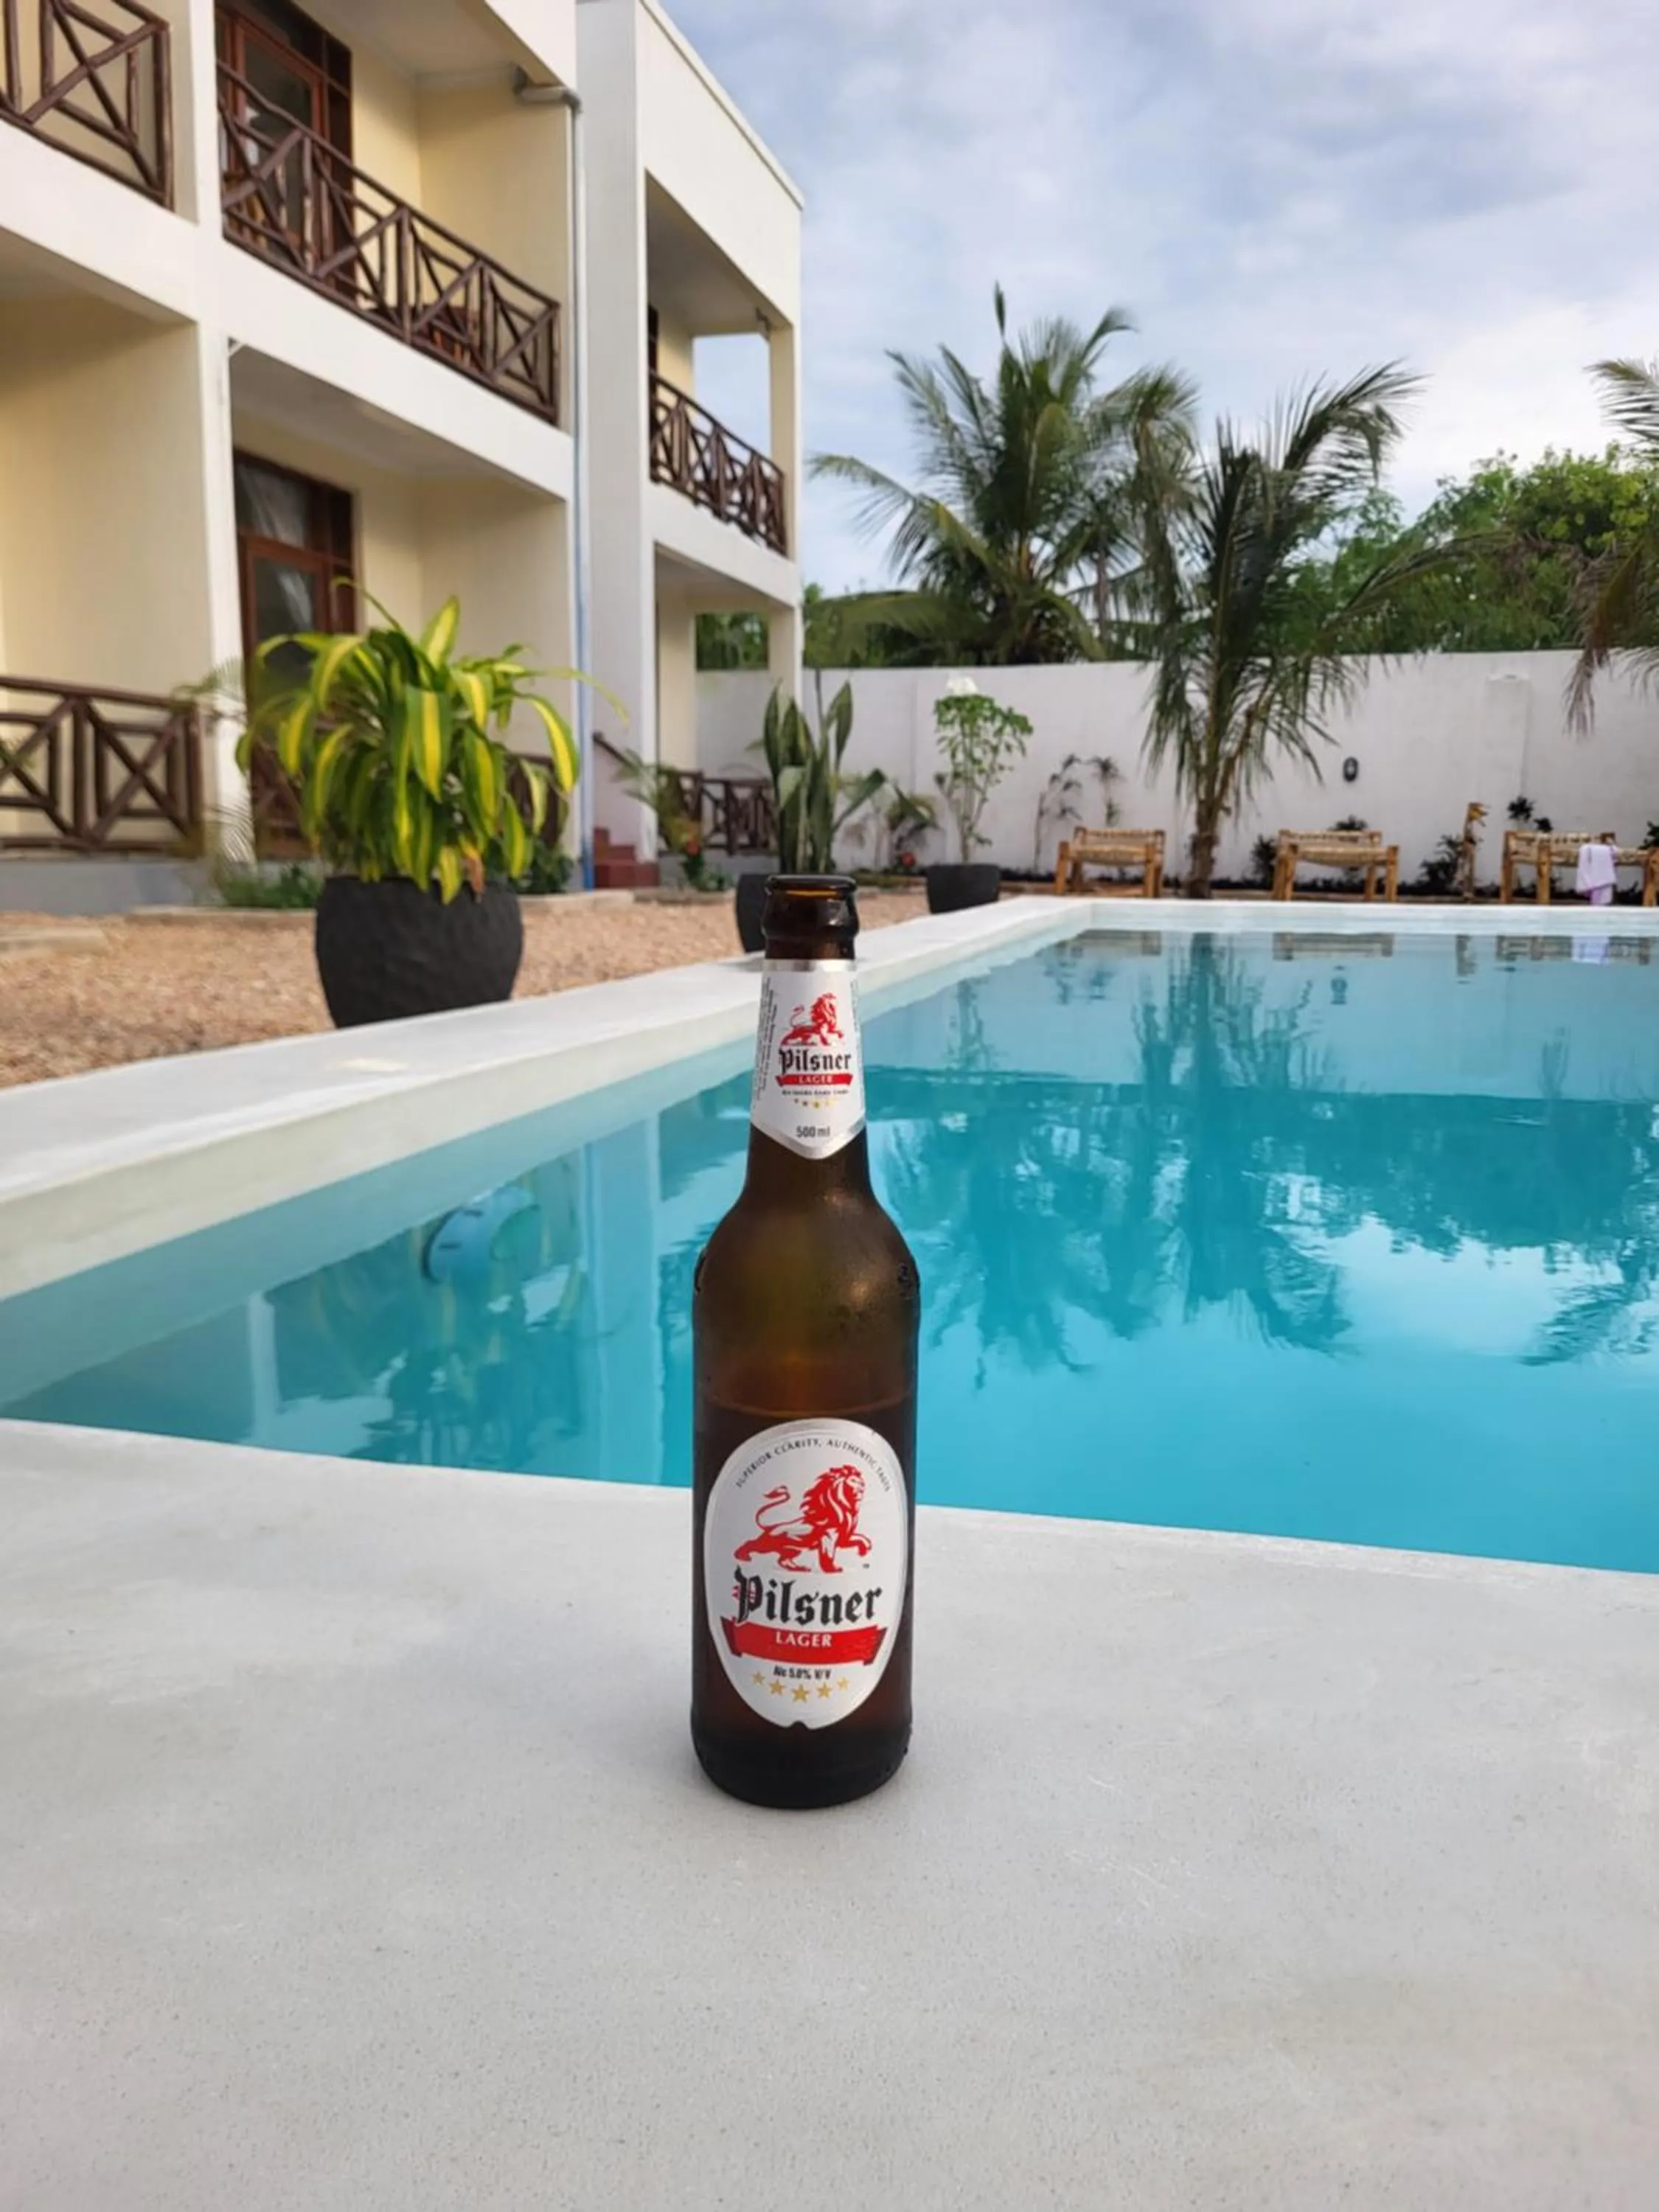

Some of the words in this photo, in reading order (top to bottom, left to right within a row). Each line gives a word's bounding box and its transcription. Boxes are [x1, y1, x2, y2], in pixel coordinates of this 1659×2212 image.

[779, 1048, 852, 1074] Pilsner
[799, 1075, 832, 1084] LAGER
[796, 1126, 815, 1138] 500
[817, 1126, 830, 1137] ml
[736, 1452, 772, 1488] SUPERIOR
[827, 1439, 877, 1470] AUTHENTIC
[734, 1565, 883, 1627] Pilsner
[775, 1630, 832, 1648] LAGER
